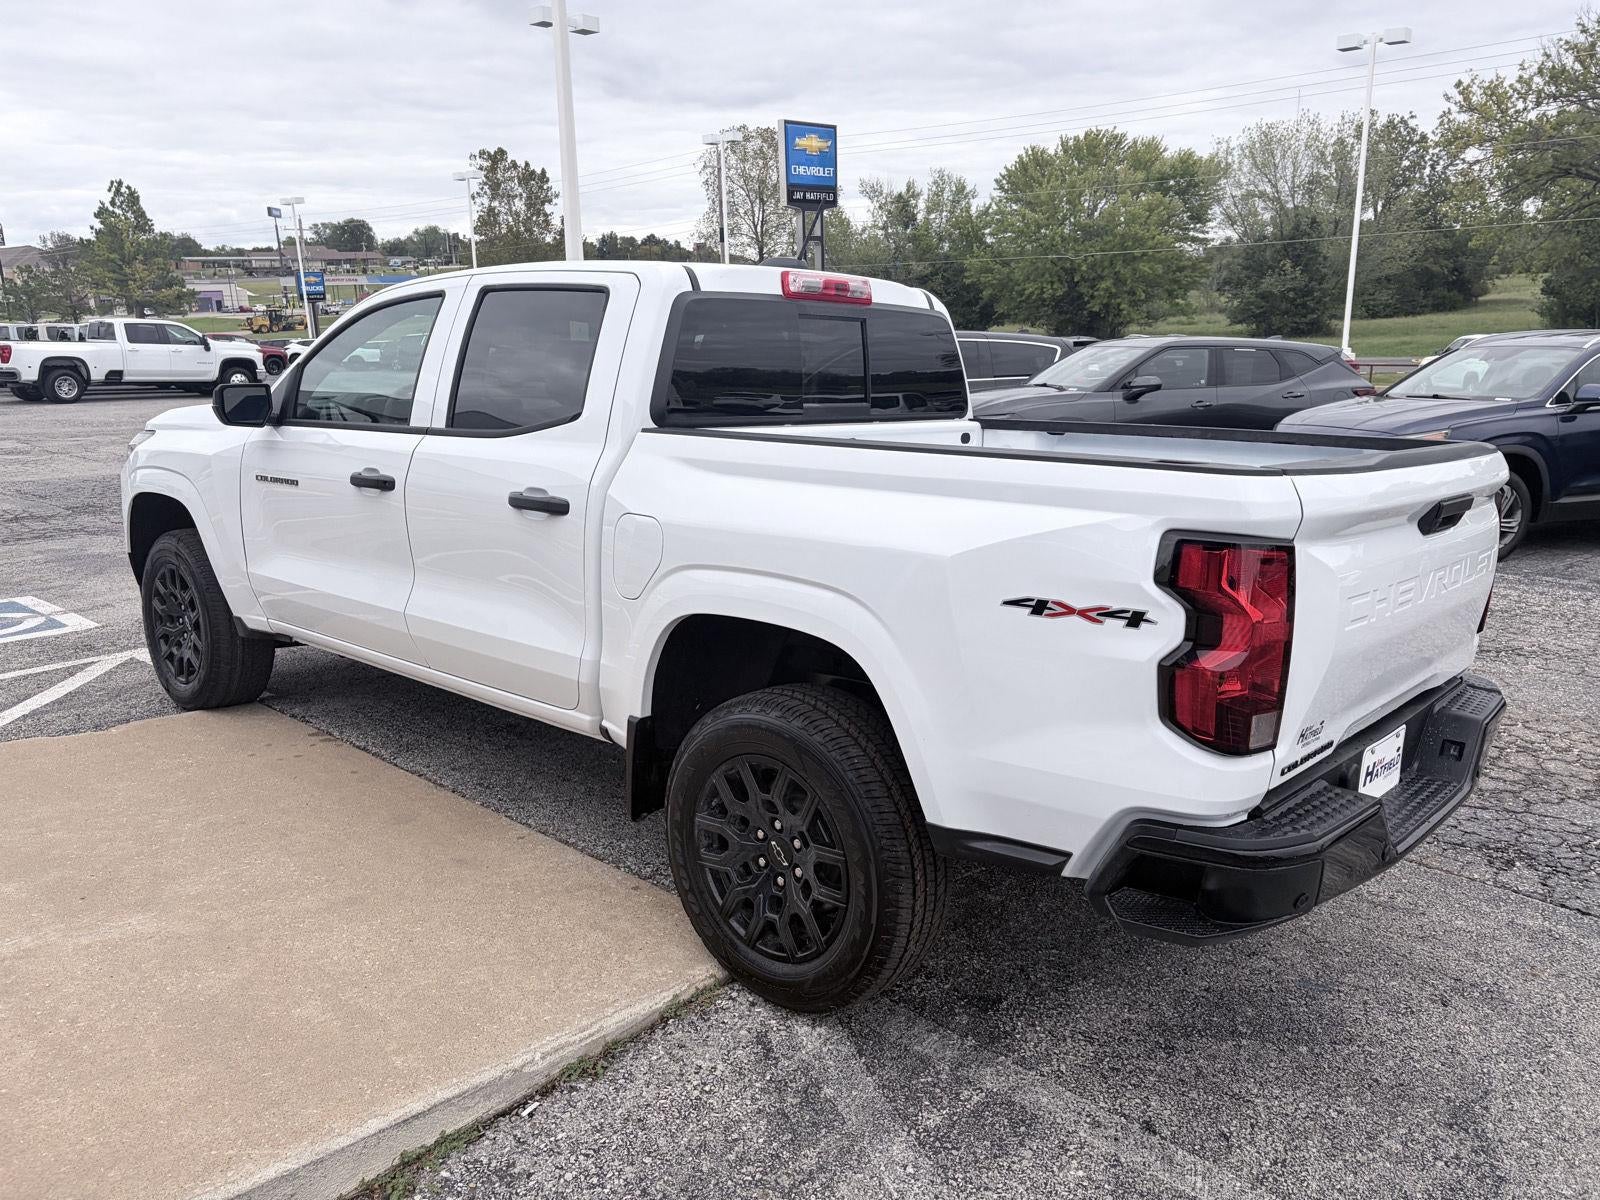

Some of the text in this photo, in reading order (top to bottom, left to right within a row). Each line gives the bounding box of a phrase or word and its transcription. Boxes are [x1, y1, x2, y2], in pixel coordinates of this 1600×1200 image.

[791, 165, 834, 177] CHEVROLET
[793, 191, 834, 201] JAY HATFIELD
[255, 474, 299, 486] COLORADO
[1345, 544, 1498, 631] CHEVROLET
[1375, 756, 1386, 768] JAY
[1362, 753, 1401, 788] HATFIELD
